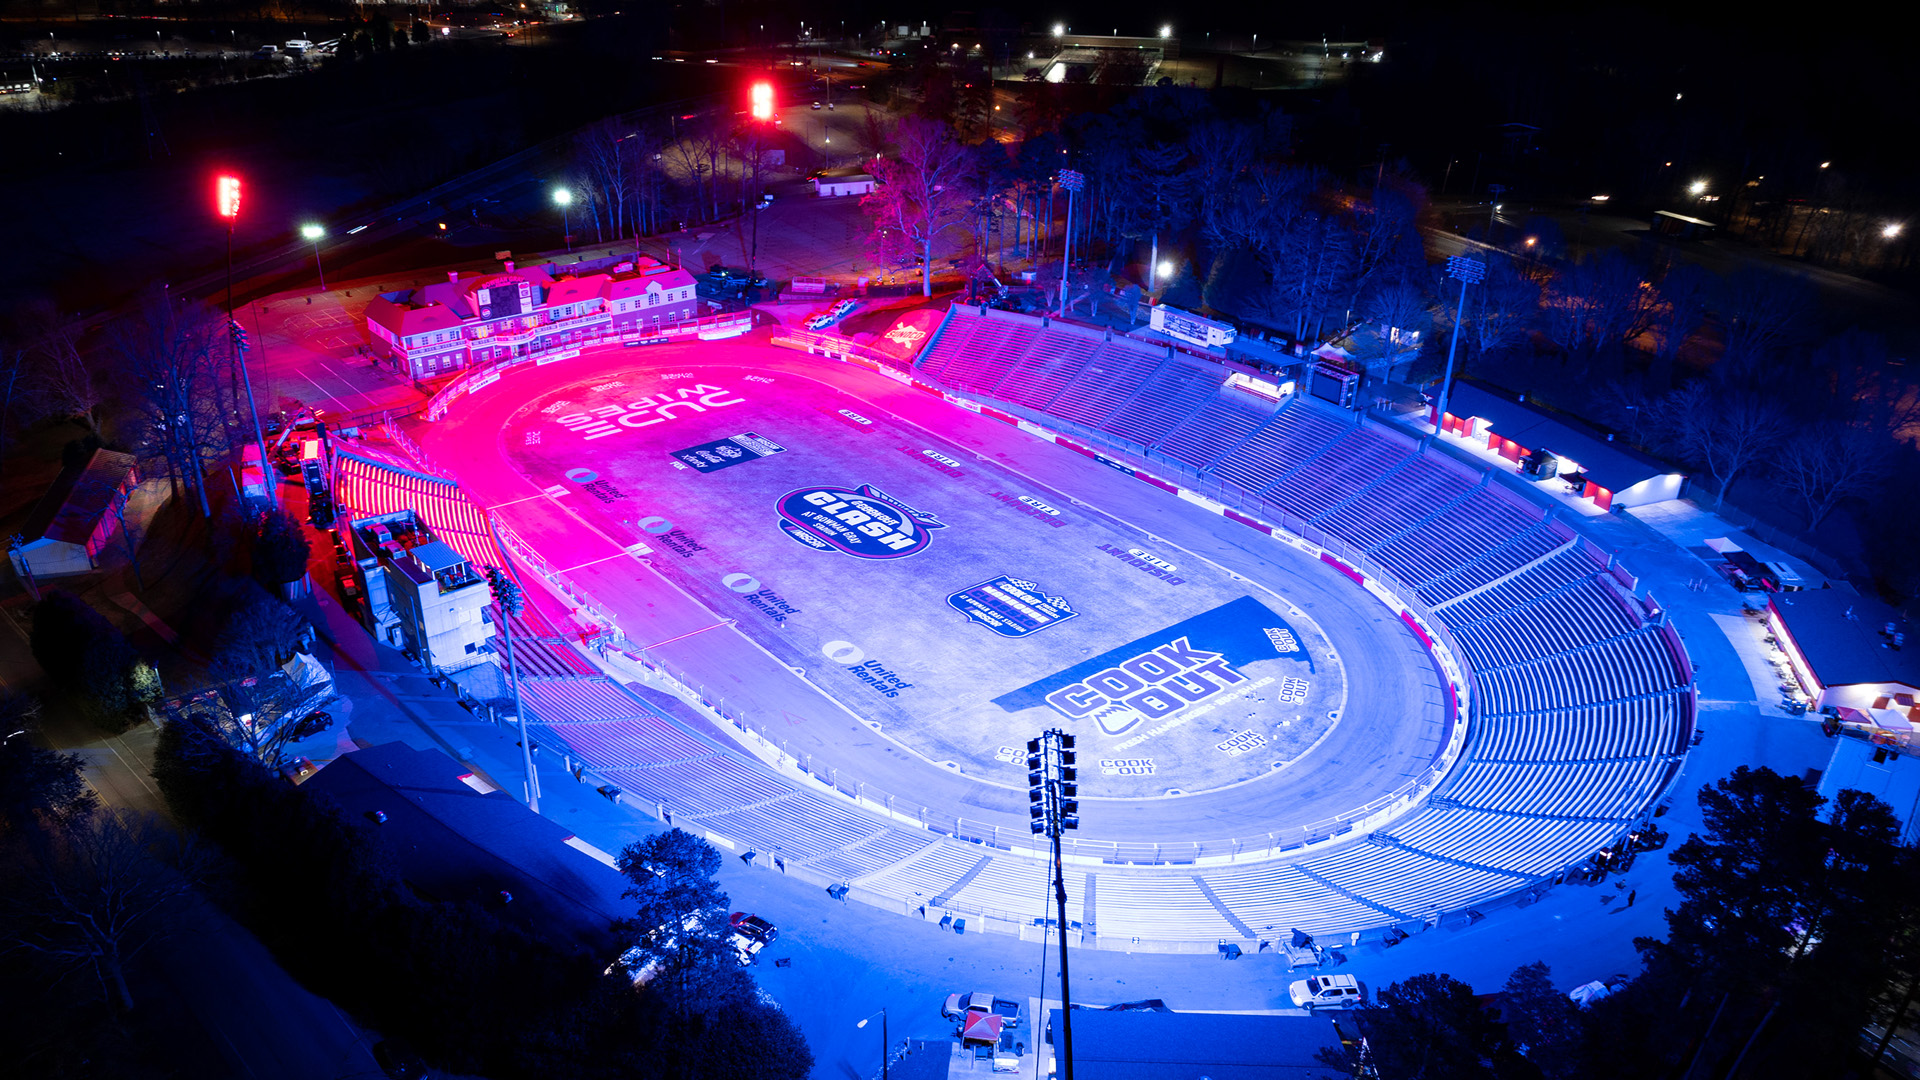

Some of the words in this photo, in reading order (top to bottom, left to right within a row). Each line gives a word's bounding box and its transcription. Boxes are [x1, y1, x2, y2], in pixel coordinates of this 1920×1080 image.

[482, 277, 508, 289] BOWMAN
[887, 330, 924, 339] SUNOCO
[556, 383, 723, 428] WIPES
[569, 390, 746, 440] DUDE
[840, 410, 868, 424] TIRE
[669, 460, 688, 470] FOX
[896, 446, 965, 478] DISCOUNT
[926, 450, 956, 466] TIRE
[581, 483, 614, 504] Rentals
[595, 480, 629, 499] United
[988, 491, 1067, 528] DISCOUNT
[1021, 496, 1054, 514] TIRE
[803, 491, 917, 550] CLASH
[813, 514, 849, 532] BOWMAN
[843, 531, 862, 544] GRAY
[813, 522, 838, 536] STADIUM
[656, 534, 694, 559] Rentals
[670, 530, 706, 552] United
[790, 530, 826, 548] NASCAR
[1096, 544, 1186, 586] DISCOUNT
[1133, 550, 1170, 569] TIRE
[758, 589, 800, 615] United
[982, 585, 1050, 623] MADHOUSE
[1000, 584, 1027, 598] COOK
[1020, 594, 1042, 605] OUT
[743, 593, 787, 623] Rentals
[966, 598, 990, 612] BOWMAN
[988, 611, 1004, 619] GRAY
[1002, 618, 1027, 632] STADIUM
[969, 609, 1003, 627] NASCAR
[971, 590, 1038, 627] CLASSIC
[1264, 628, 1290, 652] COOK
[847, 665, 899, 698] Rentals
[863, 660, 913, 689] United
[1046, 637, 1223, 718] COOK
[1123, 658, 1248, 719] OUT
[1280, 677, 1296, 703] COOK
[1294, 679, 1308, 698] OUT
[1113, 734, 1149, 752] FRESH
[1147, 704, 1216, 737] HAMBURGERS
[1238, 676, 1276, 695] SHAKES
[999, 747, 1029, 758] CO
[1217, 730, 1257, 752] COOK
[1238, 736, 1266, 752] OUT
[1101, 759, 1153, 767] COOK
[1119, 767, 1155, 775] OUT
